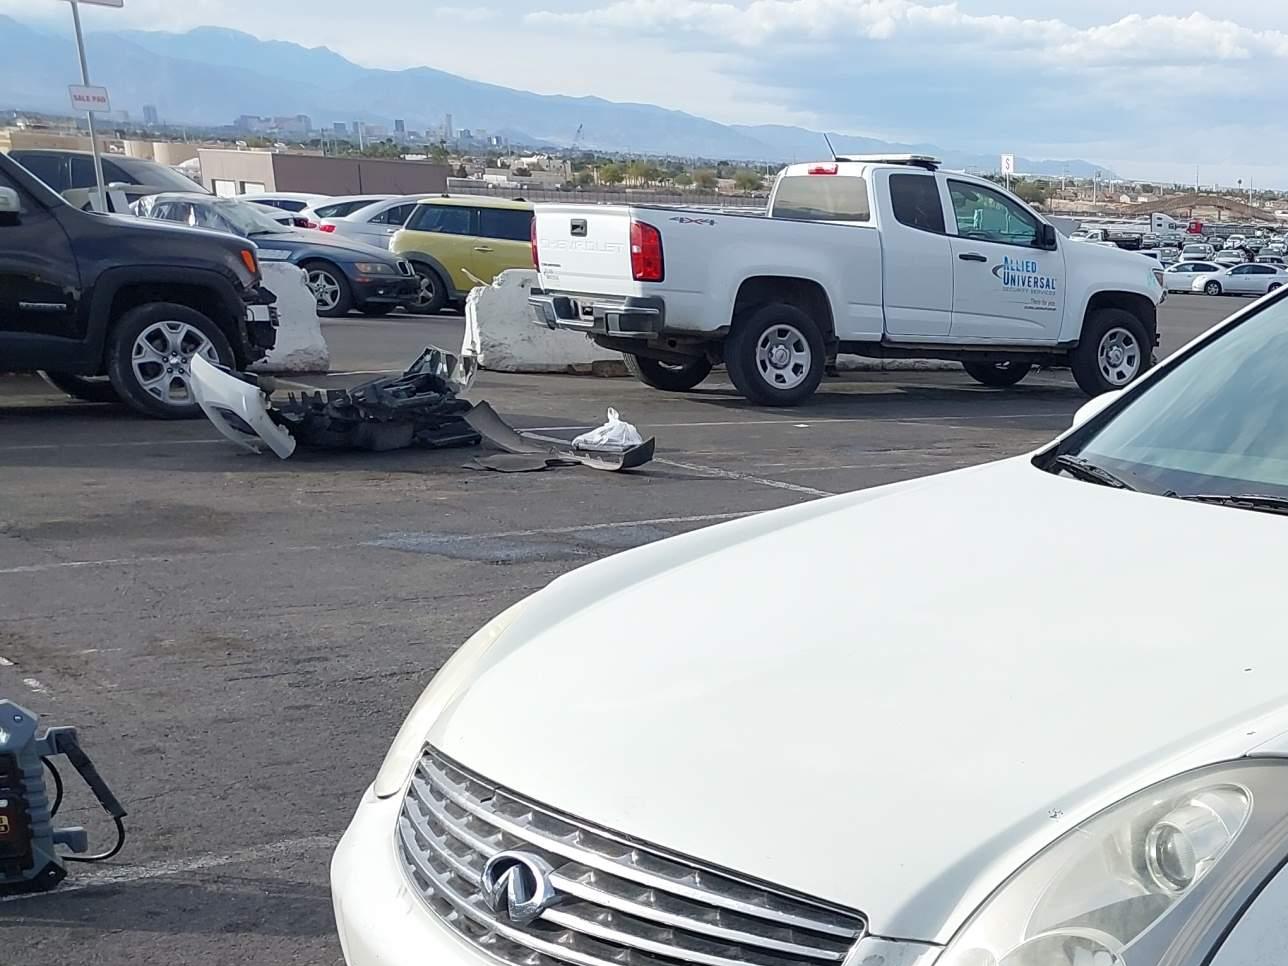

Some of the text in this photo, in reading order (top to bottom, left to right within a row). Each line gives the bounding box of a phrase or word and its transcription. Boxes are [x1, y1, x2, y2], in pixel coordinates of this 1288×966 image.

[1005, 158, 1010, 170] S
[1003, 256, 1037, 273] ALLIED
[1003, 271, 1056, 290] UNIVERSAL
